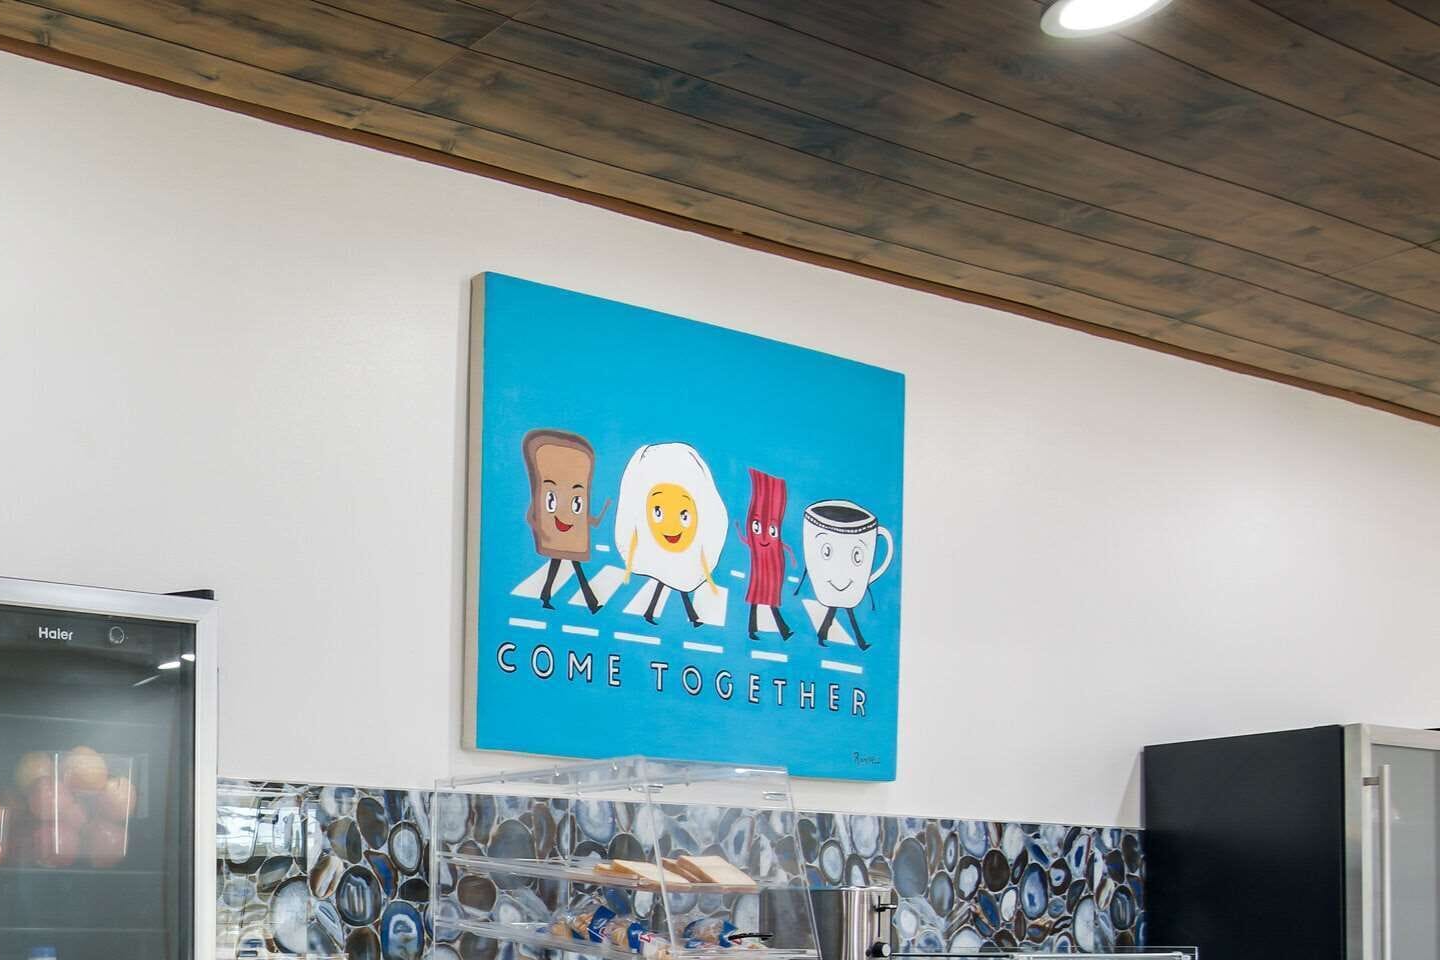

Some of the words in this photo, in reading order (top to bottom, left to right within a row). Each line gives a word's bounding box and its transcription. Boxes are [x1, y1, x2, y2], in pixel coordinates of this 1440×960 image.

[39, 626, 73, 640] Haier
[496, 641, 621, 687] COME
[650, 661, 867, 716] TOGETHER
